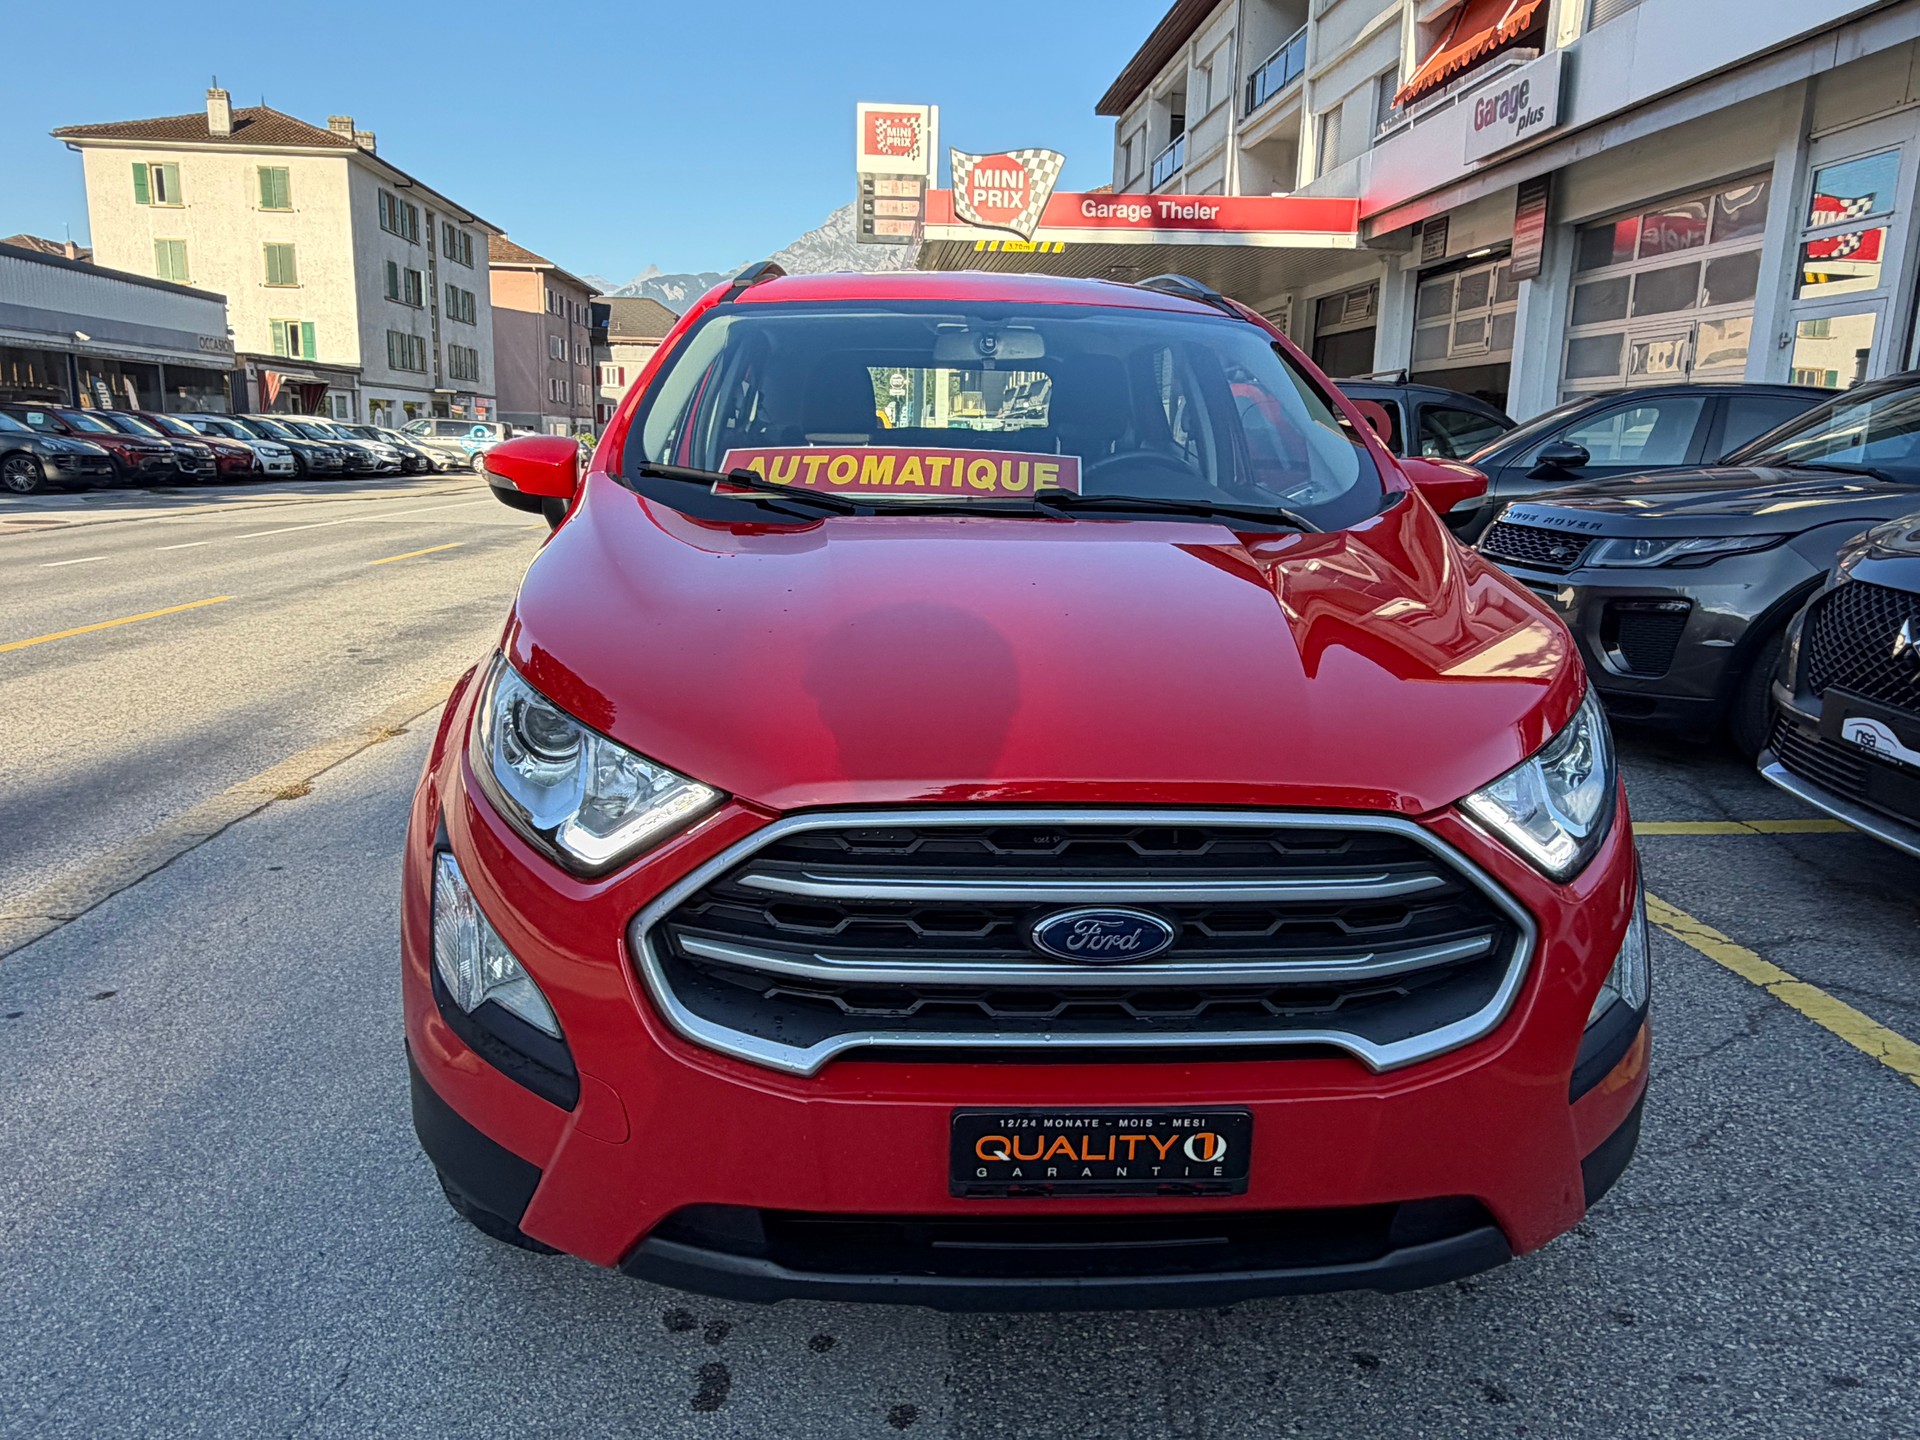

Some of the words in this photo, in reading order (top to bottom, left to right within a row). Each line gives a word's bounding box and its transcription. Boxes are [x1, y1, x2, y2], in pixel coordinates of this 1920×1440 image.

[1473, 79, 1530, 132] Garage
[1515, 105, 1545, 137] plus
[886, 127, 912, 138] MINI
[886, 137, 912, 147] PRIX
[973, 168, 1025, 189] MINI
[972, 188, 1024, 209] PRIX
[1081, 199, 1152, 222] Garage
[1157, 201, 1220, 220] Theler
[745, 454, 1060, 492] AUTOMATIQUE
[1066, 919, 1143, 951] Ford
[999, 1118, 1037, 1128] 12/24
[1043, 1118, 1100, 1128] MONATE
[1118, 1118, 1154, 1128] MOIS
[1172, 1118, 1206, 1128] MESI
[975, 1134, 1181, 1162] QUALITY
[976, 1166, 1223, 1178] GARANTIE
